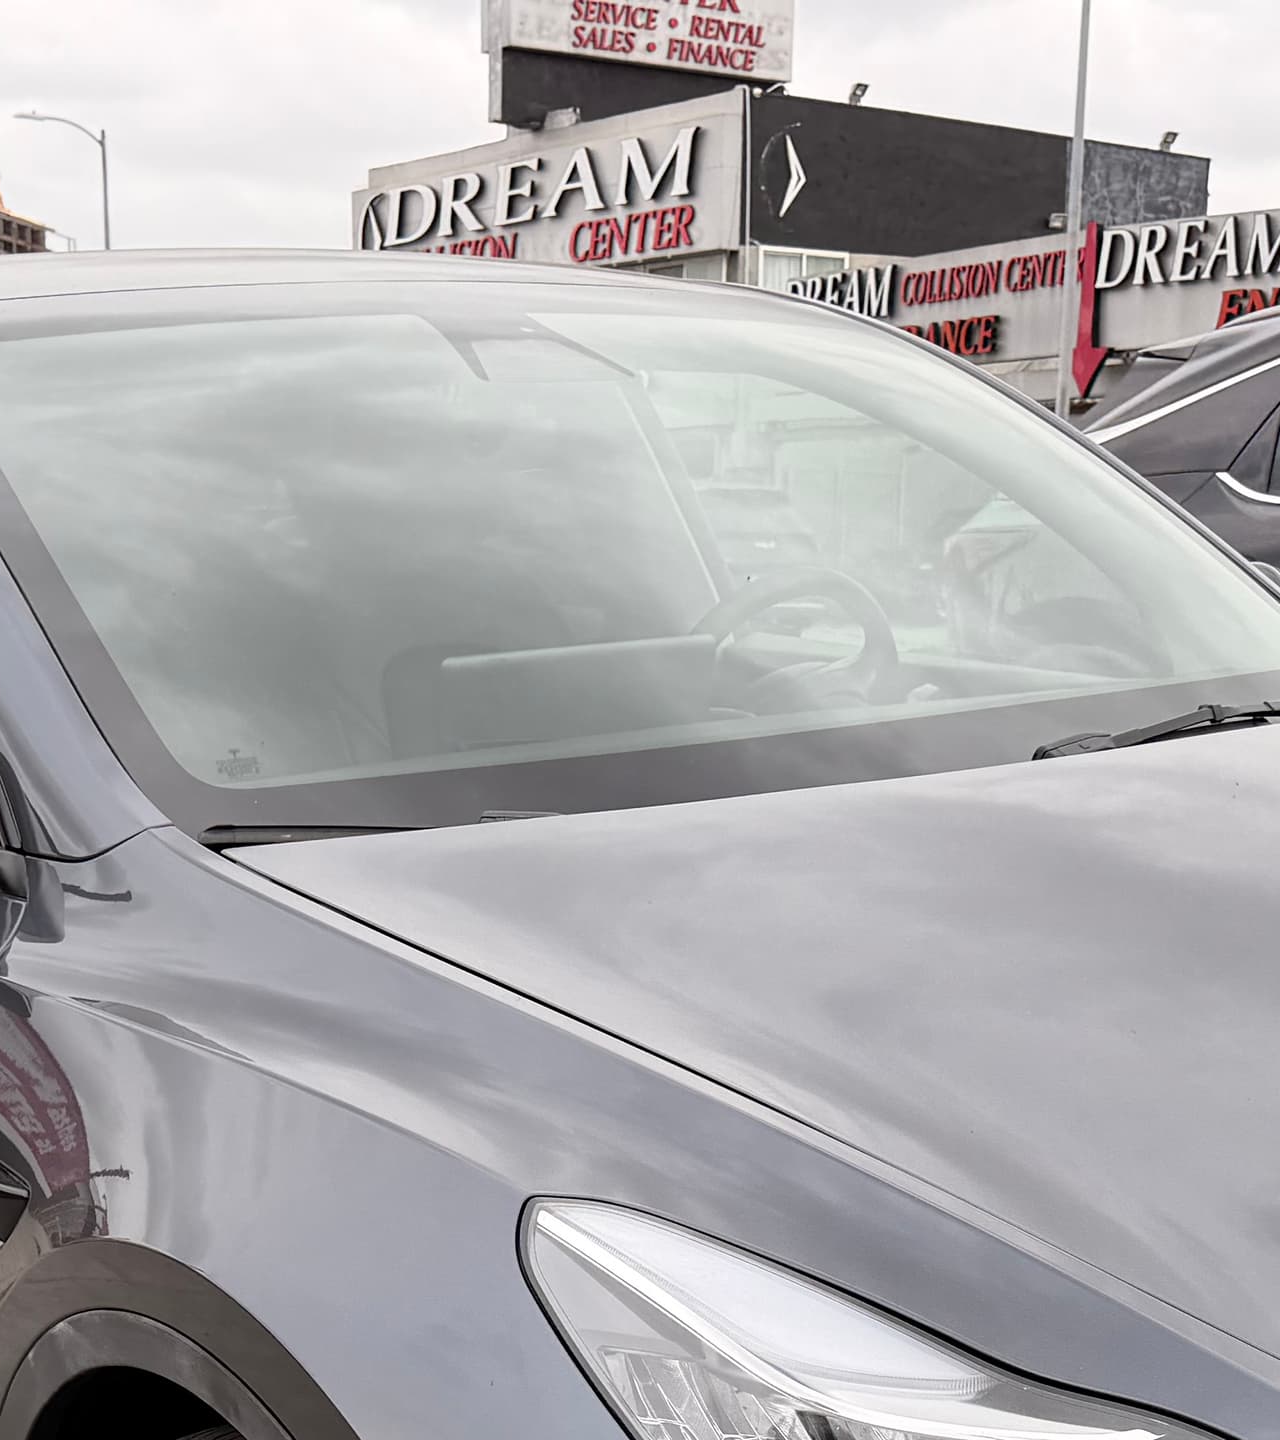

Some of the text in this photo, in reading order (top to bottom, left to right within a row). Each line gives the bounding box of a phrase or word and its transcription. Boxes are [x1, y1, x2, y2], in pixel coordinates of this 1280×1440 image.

[571, 0, 658, 30] SERVICE
[689, 15, 766, 48] RENTAL
[572, 26, 756, 71] SALES FINANCE
[382, 126, 701, 248] DREAM
[568, 204, 695, 263] CENTER
[786, 264, 897, 318] REAM
[900, 260, 1002, 306] COLLISION
